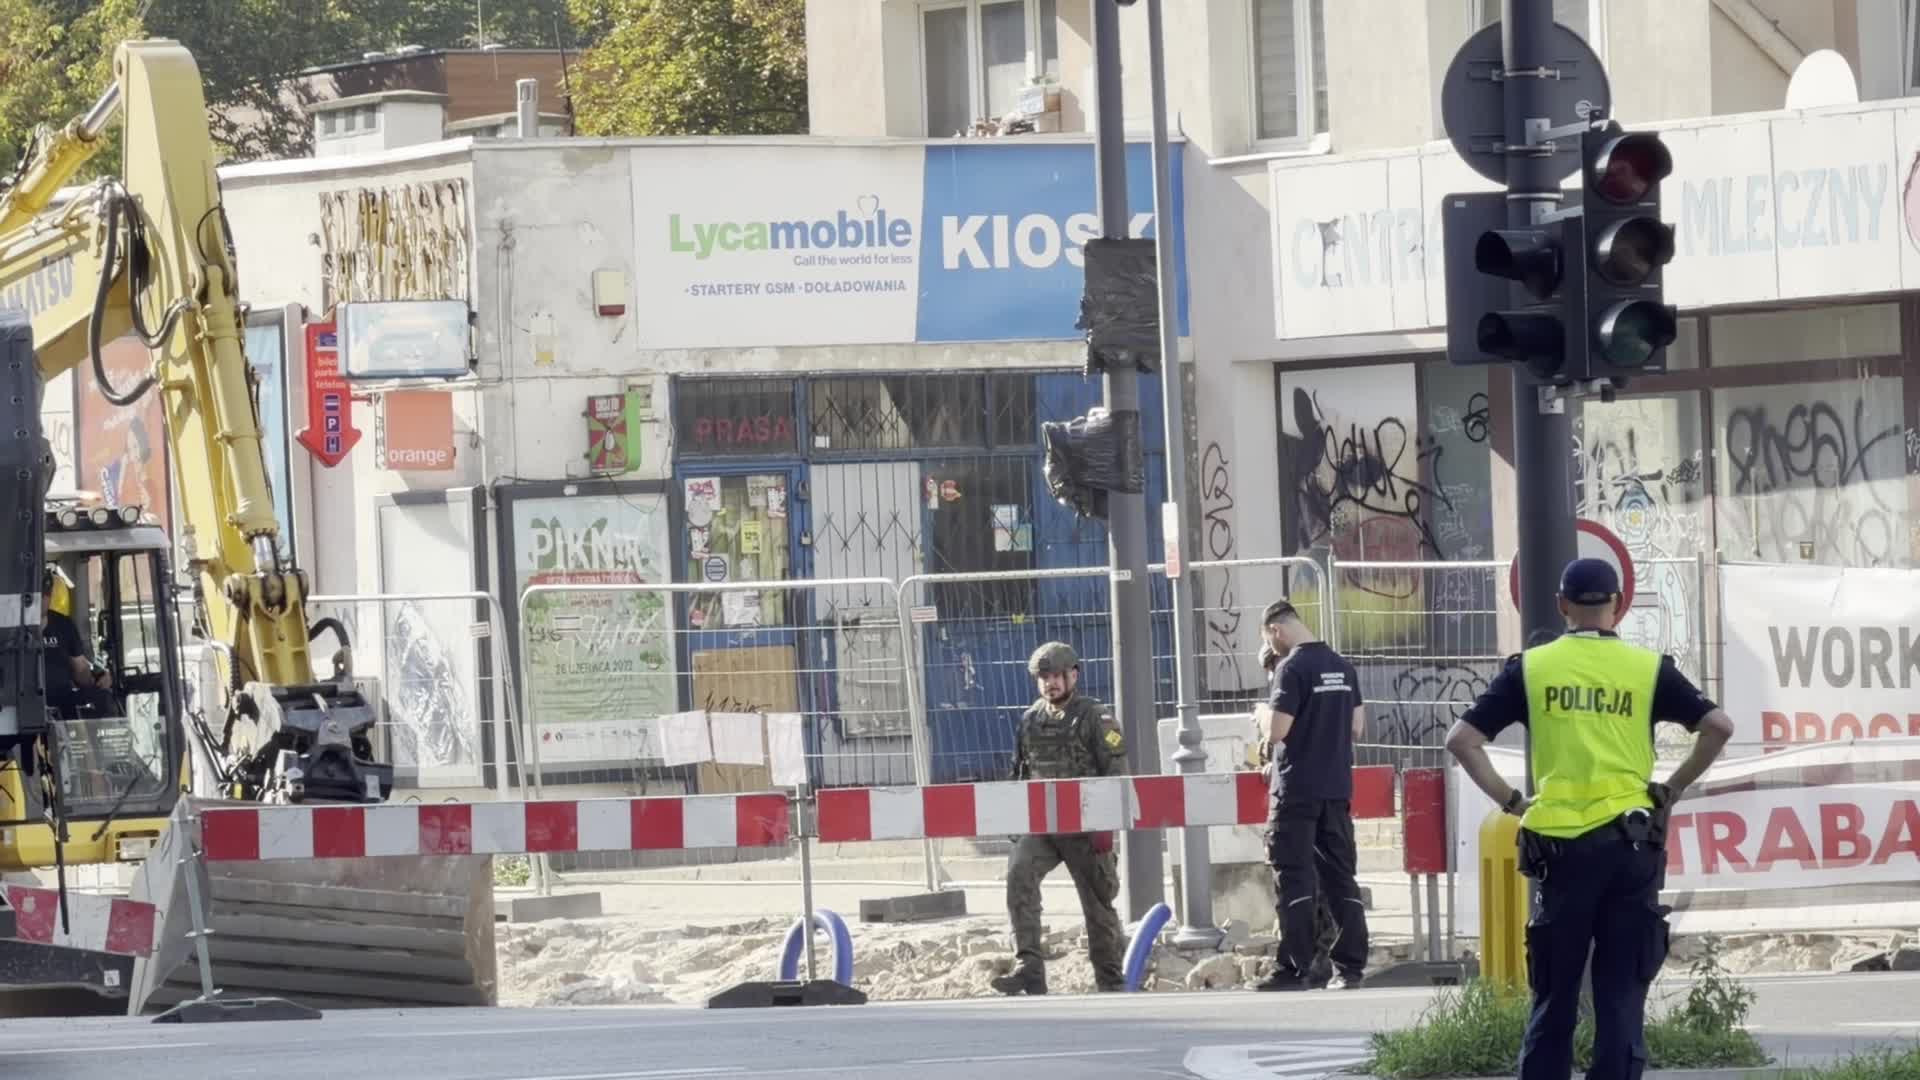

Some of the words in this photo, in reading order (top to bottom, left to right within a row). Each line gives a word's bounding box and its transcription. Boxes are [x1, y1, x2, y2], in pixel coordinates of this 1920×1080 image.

[1682, 162, 1887, 256] MLECZNY
[670, 209, 912, 260] Lycamobile
[794, 255, 816, 266] Call
[818, 255, 837, 266] the
[839, 254, 872, 265] world
[874, 254, 889, 265] for
[891, 254, 912, 264] less
[766, 282, 795, 294] GSM
[695, 415, 792, 443] PRASA
[389, 449, 447, 465] orange
[1768, 626, 1920, 689] WORK
[1545, 686, 1632, 717] POLICJA
